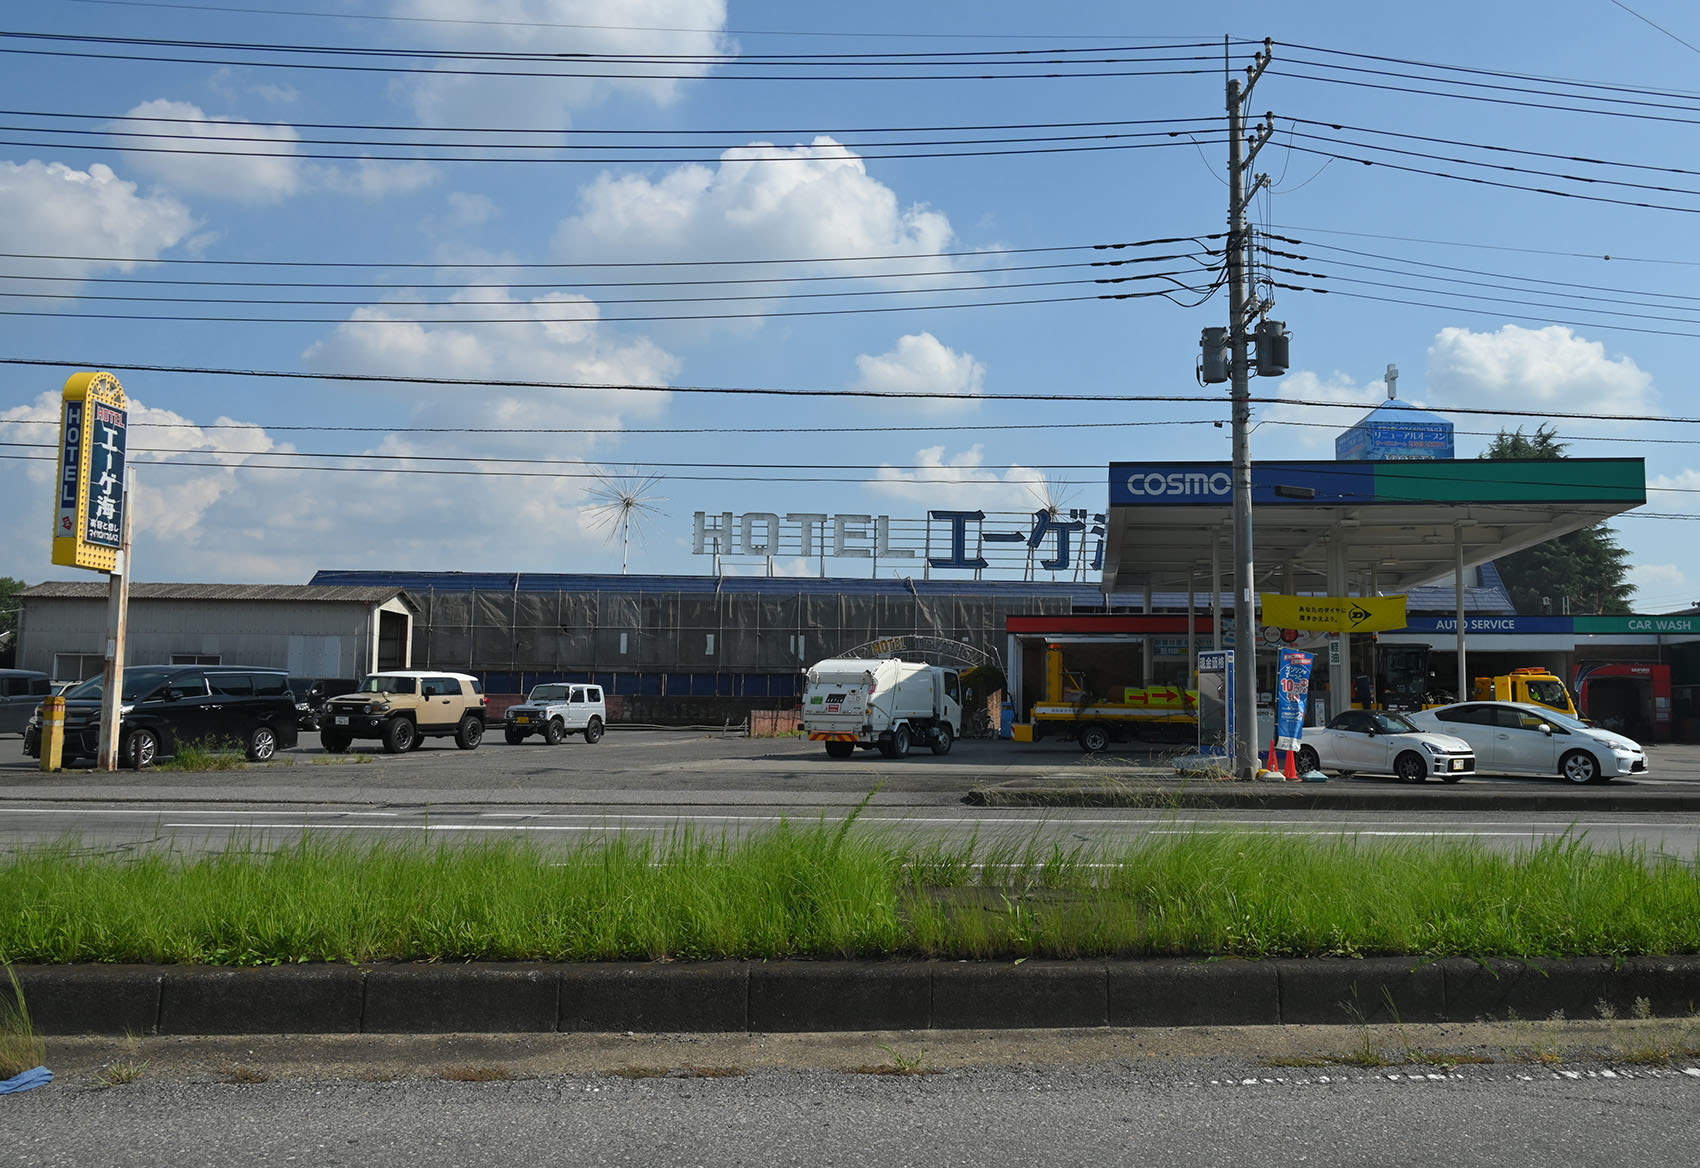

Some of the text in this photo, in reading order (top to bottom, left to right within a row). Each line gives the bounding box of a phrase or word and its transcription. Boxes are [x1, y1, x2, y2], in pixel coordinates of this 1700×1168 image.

[97, 406, 125, 427] HOTEL
[1374, 431, 1446, 441] リニューアルオープン
[63, 408, 81, 501] HOTEL
[96, 427, 118, 520] エーゲ海
[1127, 472, 1232, 496] COSMO
[693, 511, 915, 559] HOTEL
[1471, 619, 1515, 630] SERVICE
[1628, 619, 1692, 630] CAR WASH
